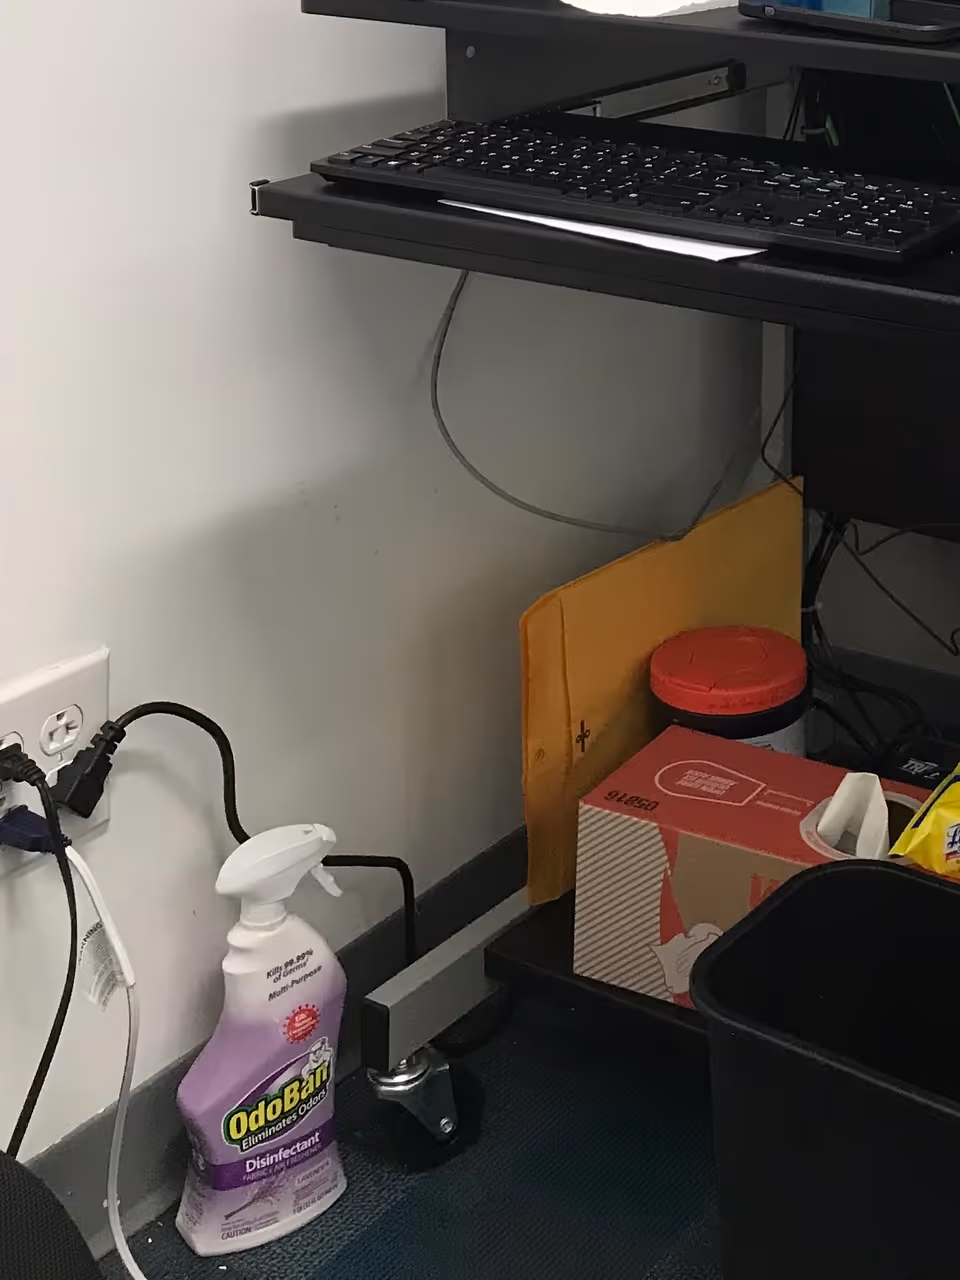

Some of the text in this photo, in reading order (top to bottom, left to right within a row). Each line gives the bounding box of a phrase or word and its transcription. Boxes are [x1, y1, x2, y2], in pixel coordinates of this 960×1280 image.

[266, 965, 283, 979] Kills
[268, 965, 323, 1002] Multi-Purpose
[273, 969, 281, 983] of
[228, 1063, 328, 1140] OdoBan
[242, 1089, 326, 1150] Eliminates Odors
[245, 1132, 320, 1173] Disinfectant
